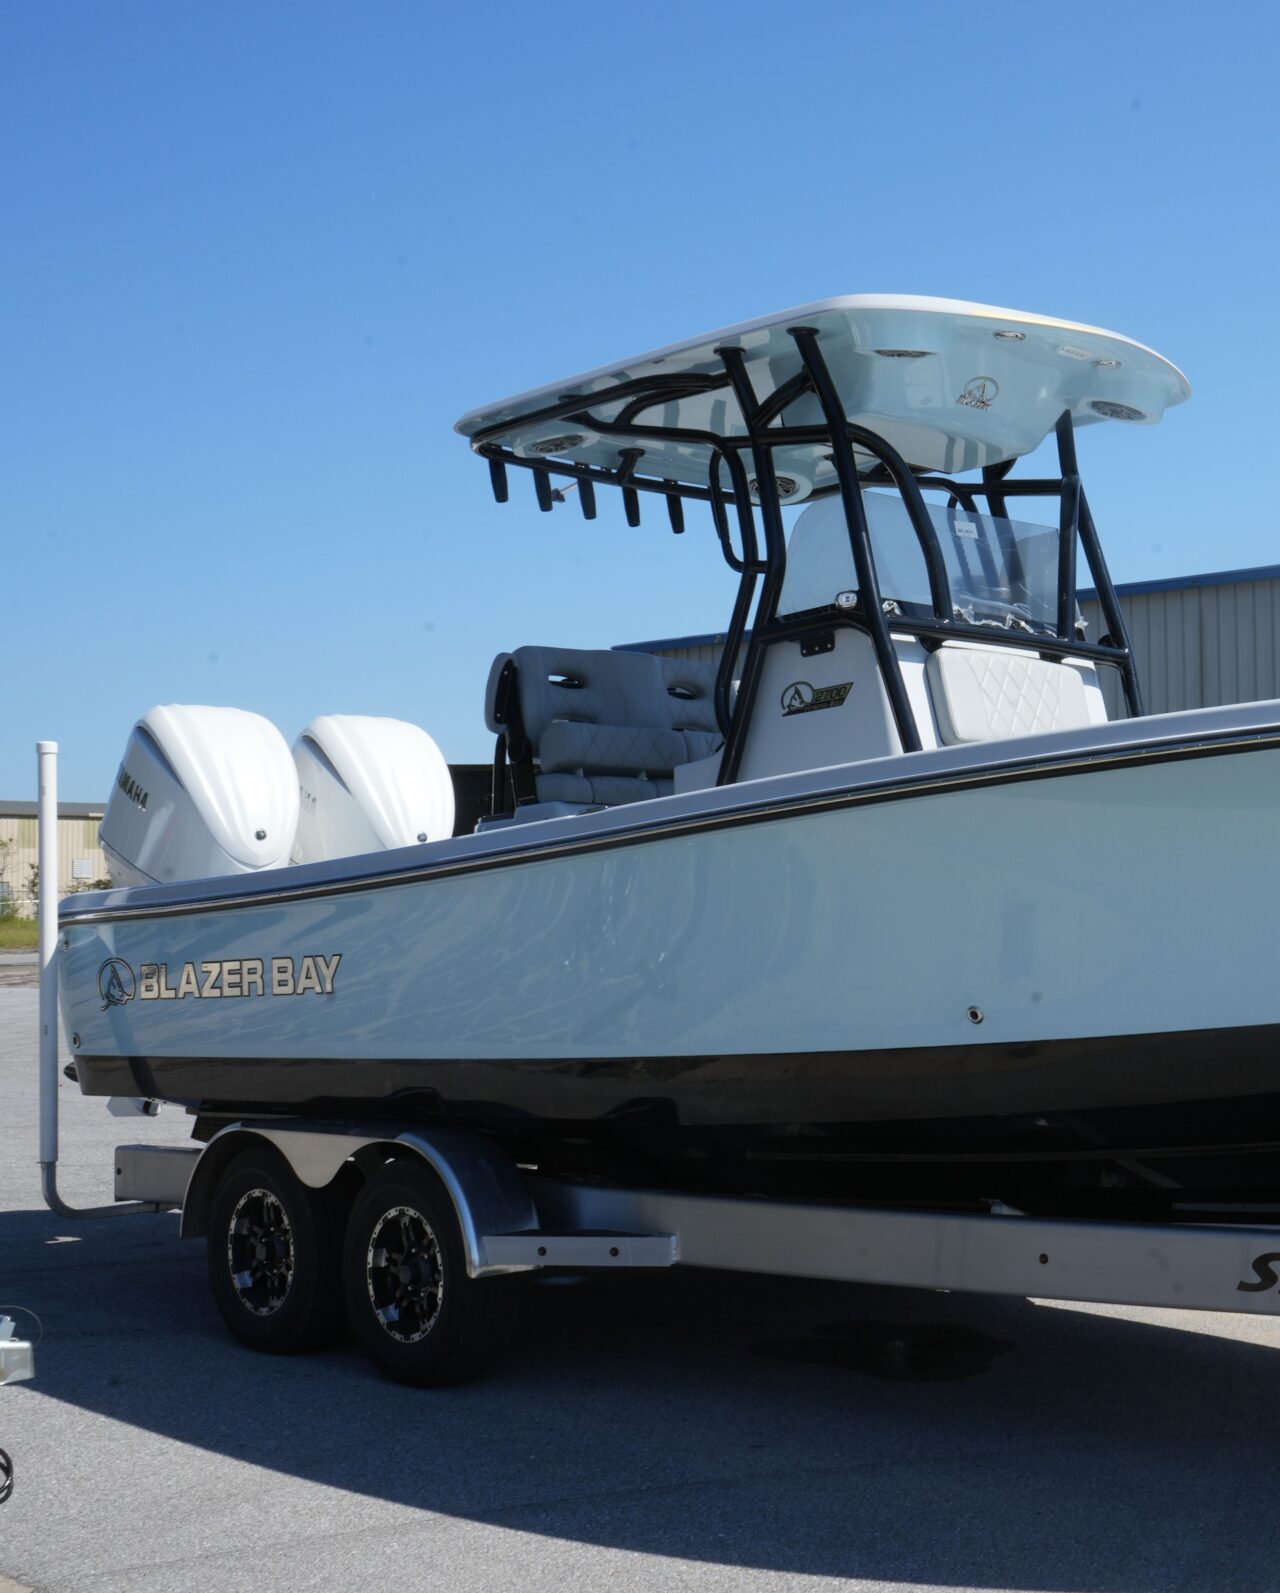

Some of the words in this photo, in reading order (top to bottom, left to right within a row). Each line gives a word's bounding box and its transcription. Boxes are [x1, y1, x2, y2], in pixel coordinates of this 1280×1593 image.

[815, 686, 847, 701] 2700
[117, 764, 149, 809] MAHA
[139, 958, 265, 1000] BLAZER
[271, 953, 343, 996] BAY
